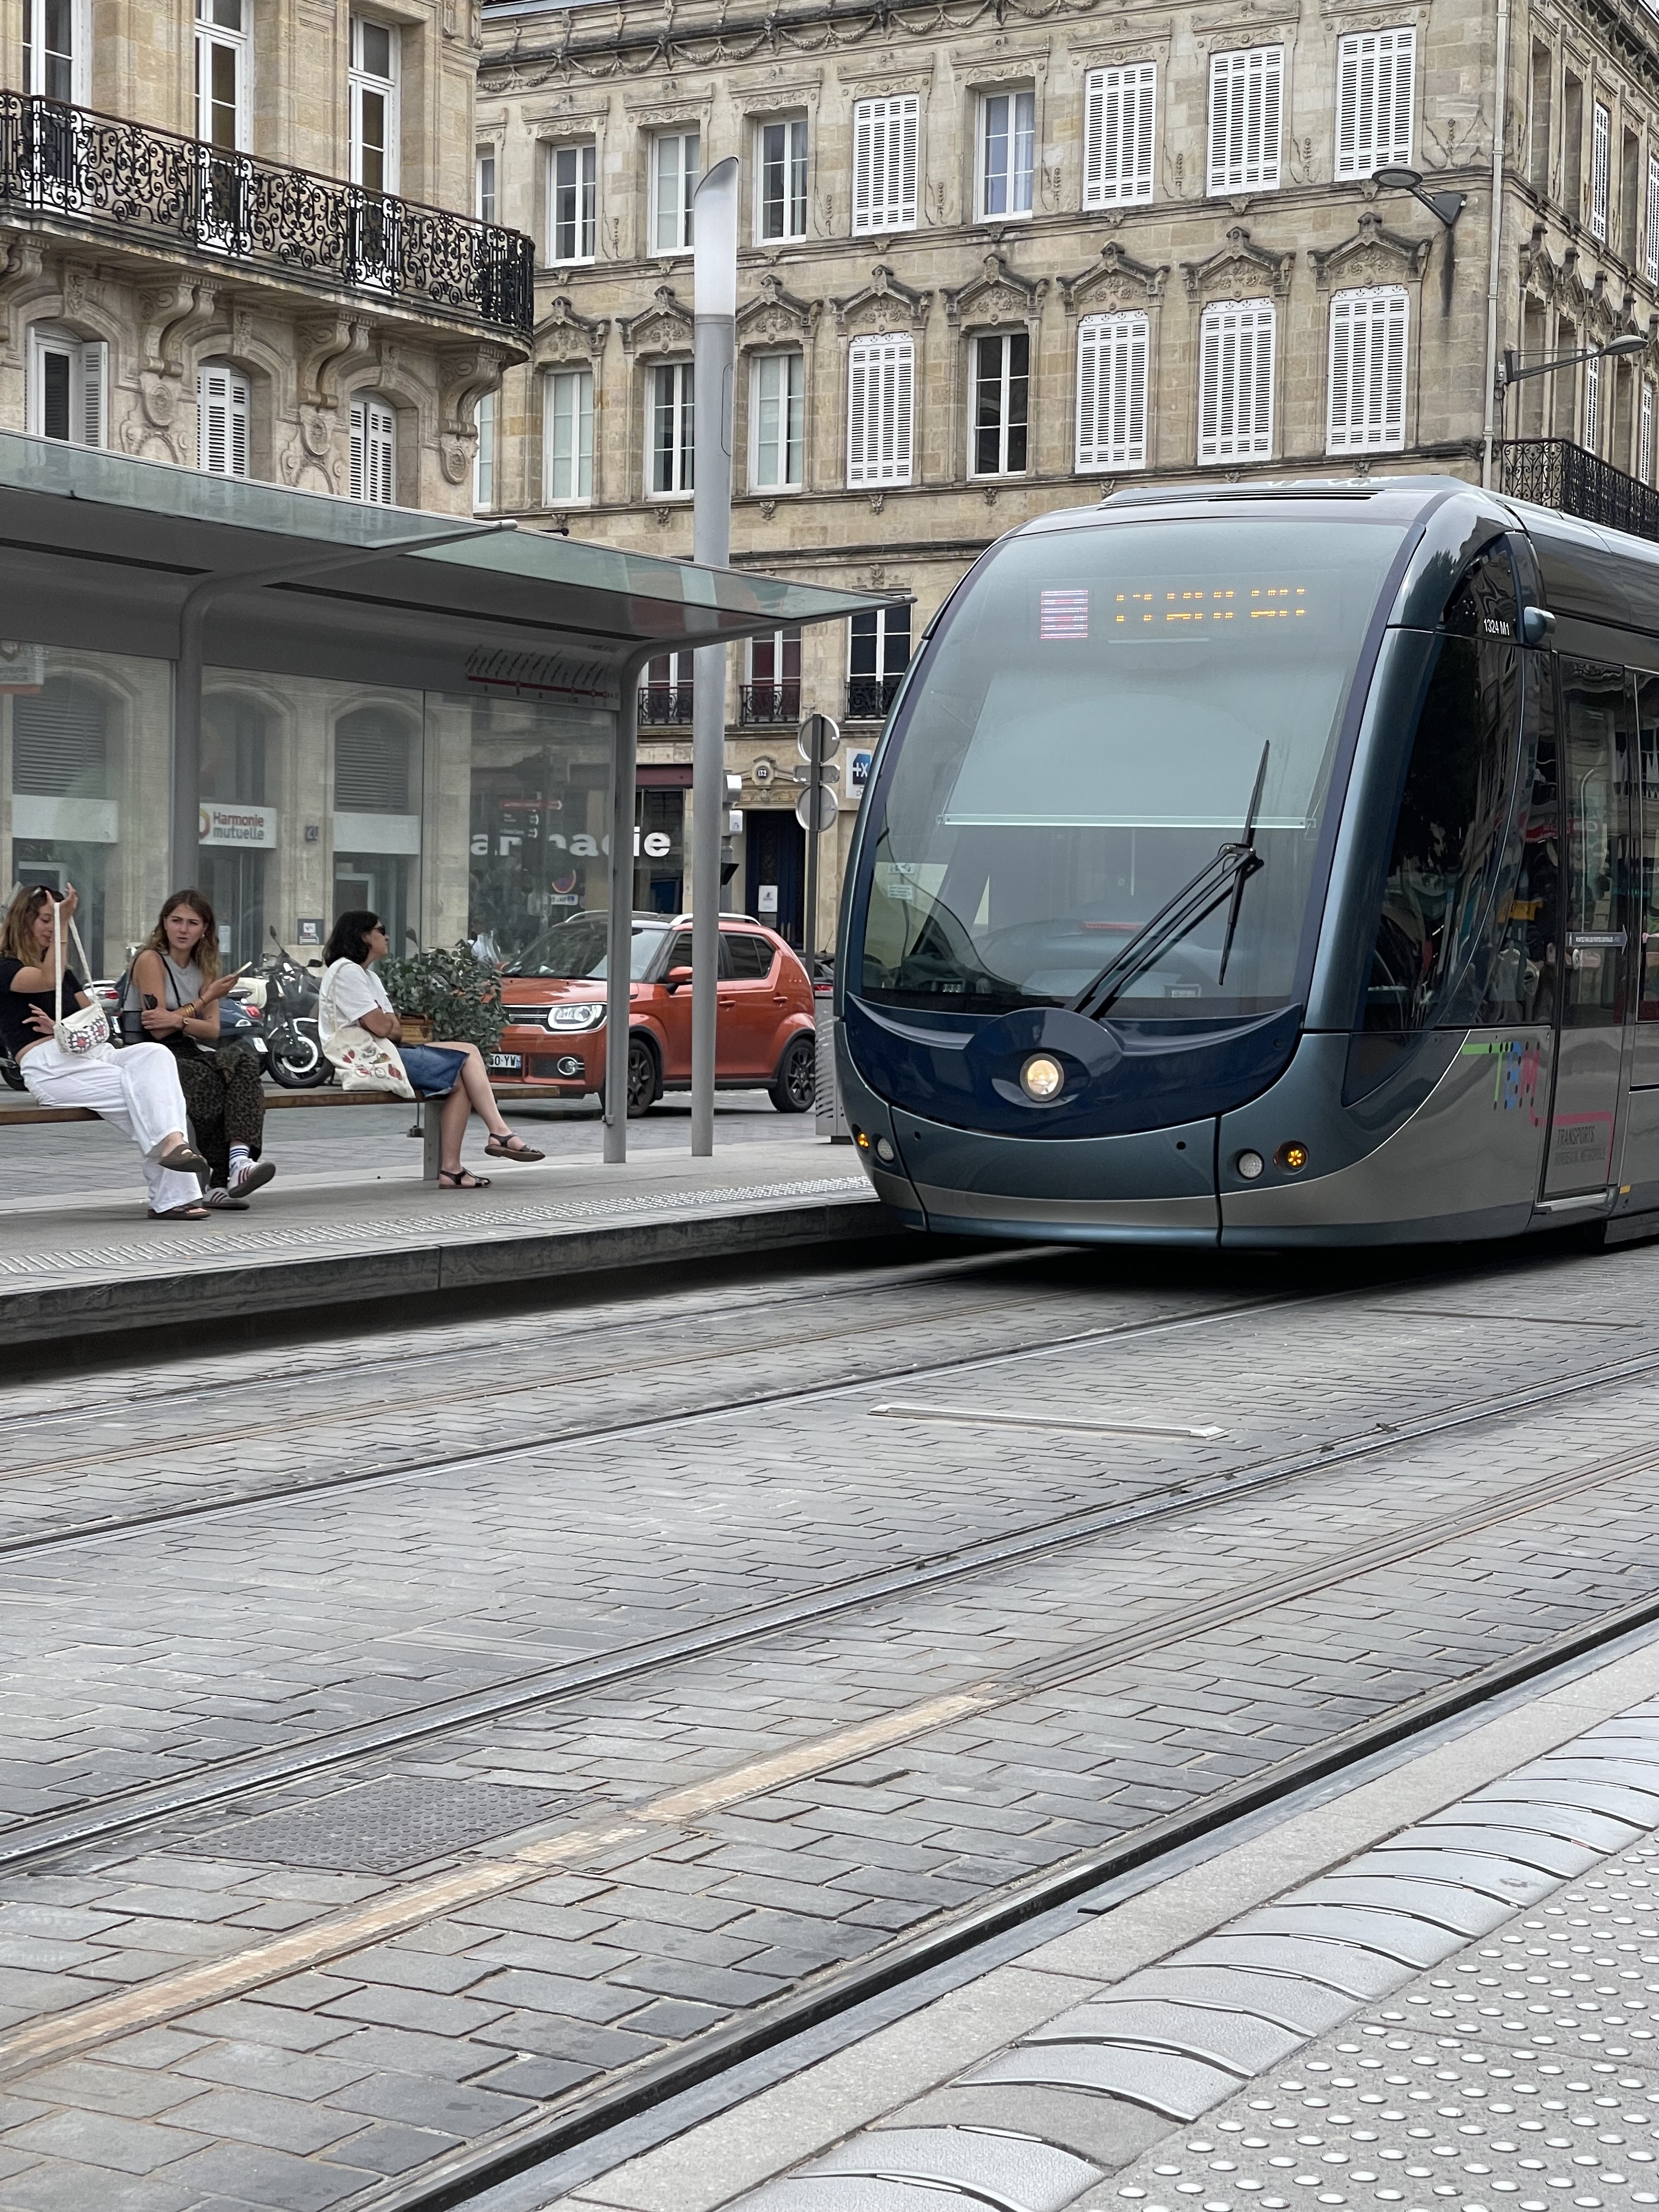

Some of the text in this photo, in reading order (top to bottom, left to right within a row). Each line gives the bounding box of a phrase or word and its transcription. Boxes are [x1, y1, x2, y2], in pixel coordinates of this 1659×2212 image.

[1483, 618, 1510, 636] 1324 M1
[213, 811, 264, 827] Harmonie
[213, 825, 264, 840] mutuelle
[1557, 1125, 1595, 1147] TRANSPORTS
